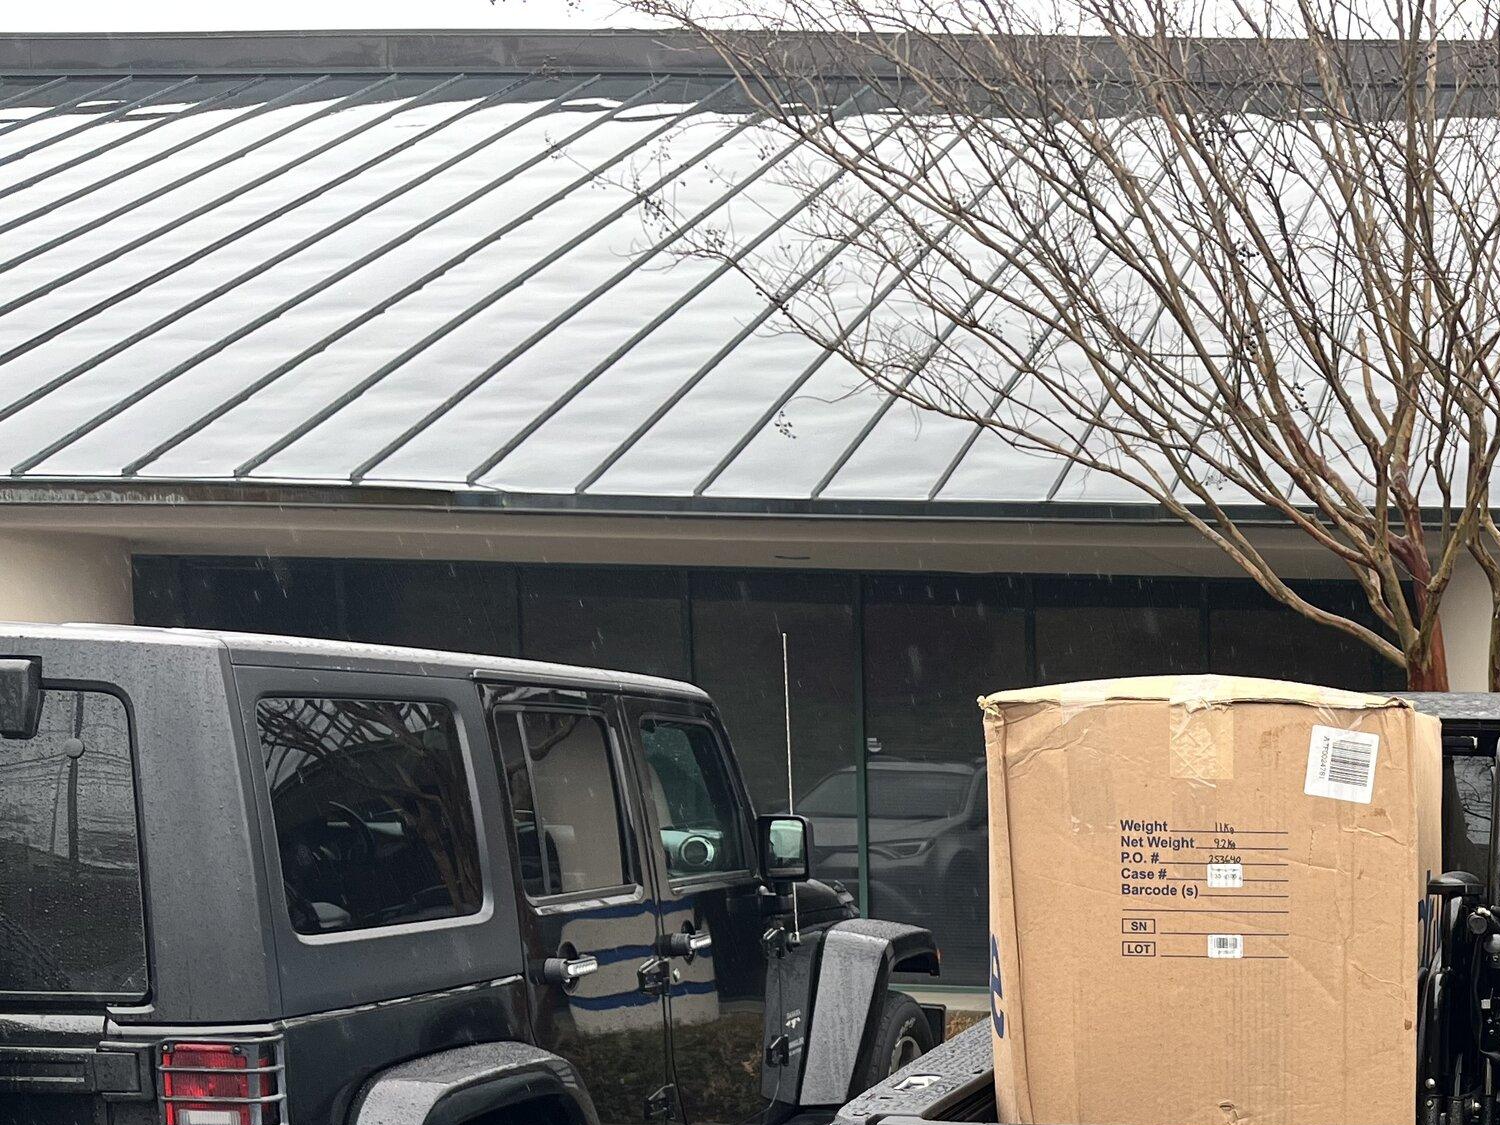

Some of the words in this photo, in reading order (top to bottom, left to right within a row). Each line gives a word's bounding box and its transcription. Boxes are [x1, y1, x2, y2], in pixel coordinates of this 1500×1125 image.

[1120, 820, 1167, 834] Weight
[1121, 836, 1143, 847] Net
[1147, 836, 1194, 851] Weight
[1121, 852, 1147, 863] P.O.
[1150, 852, 1160, 864] #
[1121, 868, 1154, 879] Case
[1157, 868, 1167, 880] #
[1121, 884, 1177, 896] Barcode
[1181, 884, 1198, 899] (s)
[1131, 921, 1147, 931] SN
[1127, 944, 1151, 953] LOT
